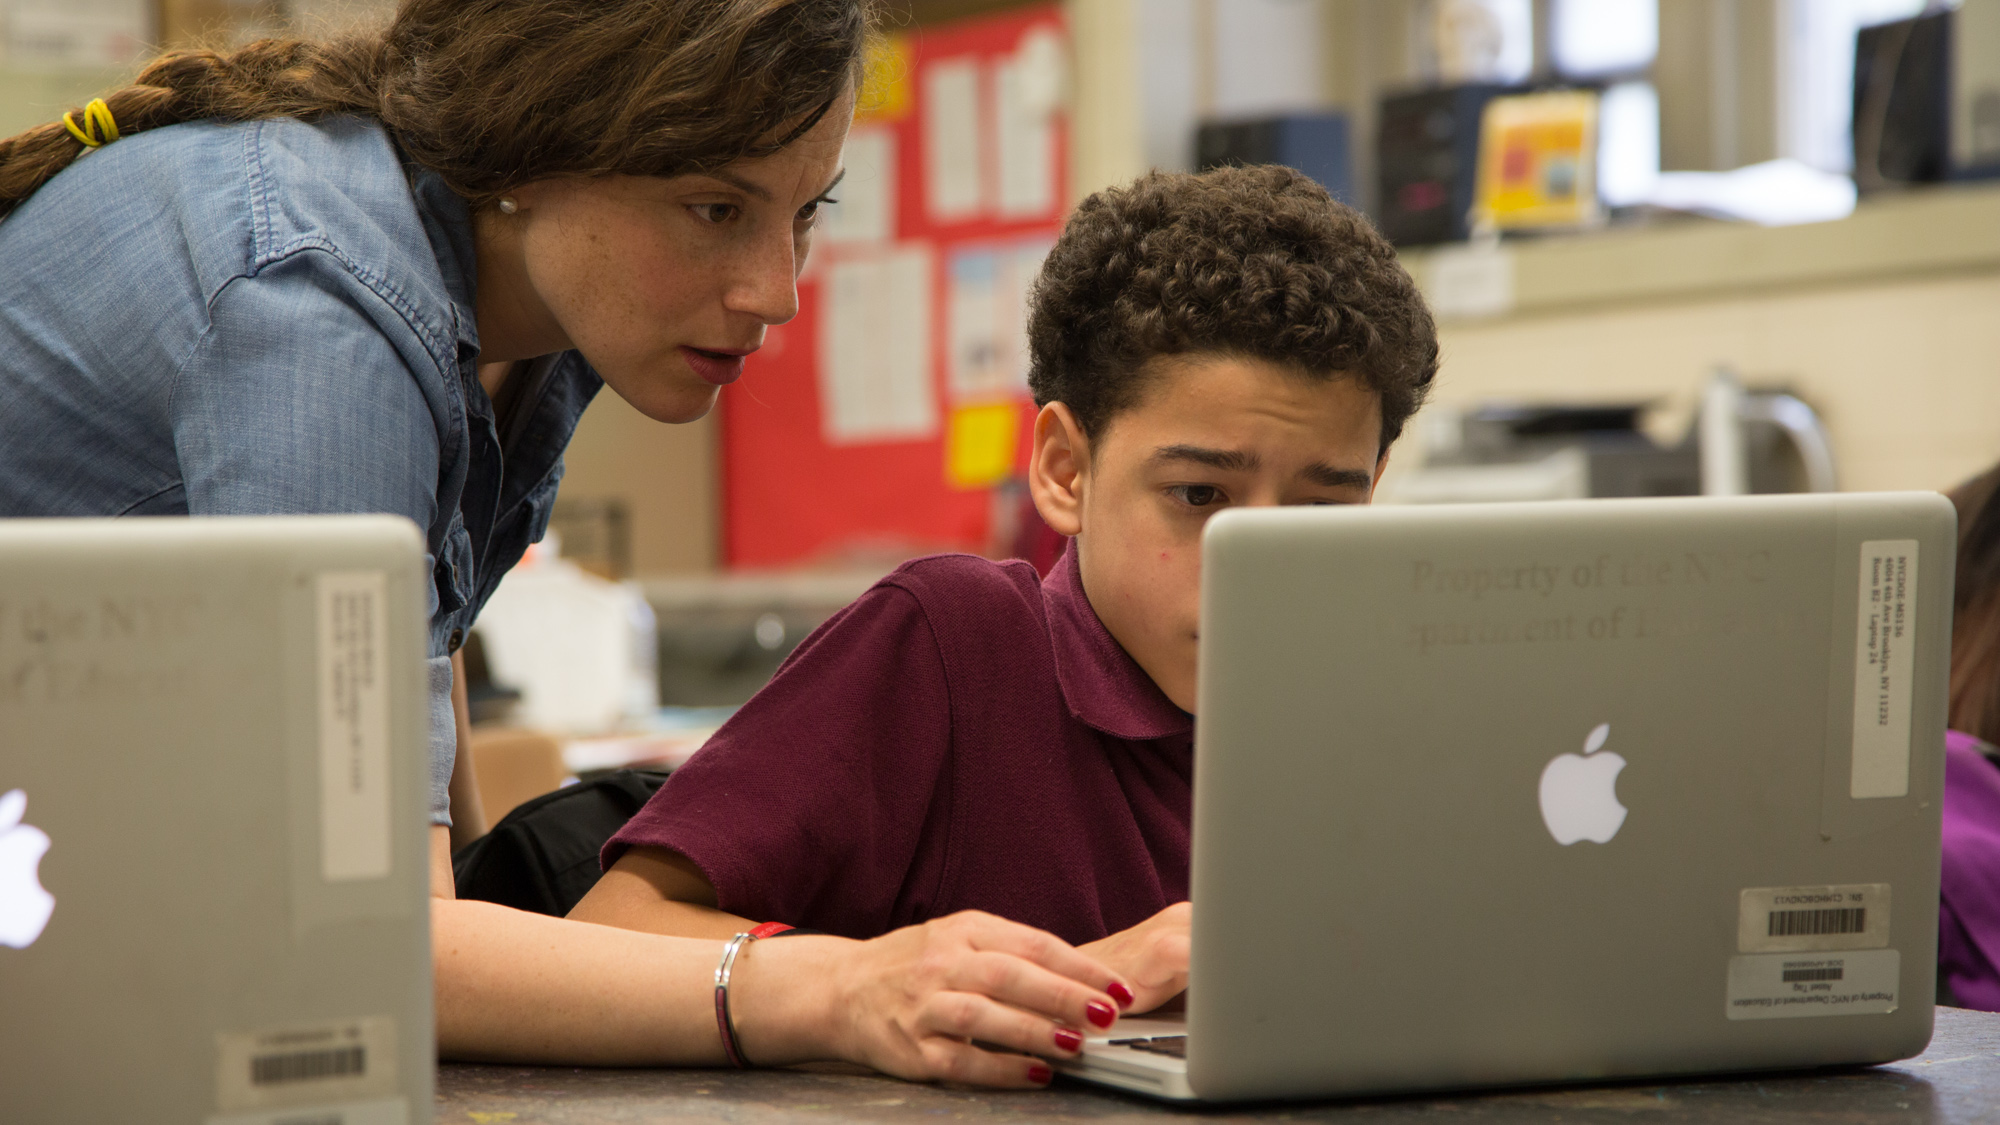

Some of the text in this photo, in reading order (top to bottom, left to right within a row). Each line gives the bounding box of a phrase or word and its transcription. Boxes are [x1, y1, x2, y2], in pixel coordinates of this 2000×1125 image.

[1570, 552, 1612, 590] of
[1684, 549, 1771, 585] NC
[1872, 557, 1882, 587] Room
[1895, 556, 1907, 638] NYCDOE-MS136
[1585, 604, 1628, 641] of
[1868, 613, 1880, 650] Laptop
[1869, 651, 1879, 665] 24
[1879, 557, 1895, 726] 4004 4th Ave Brooklyn, NY 11232
[1849, 893, 1864, 903] SN:
[1733, 991, 1894, 1007] Property of NYC Department of Education
[1793, 983, 1832, 993] Asset Tag
